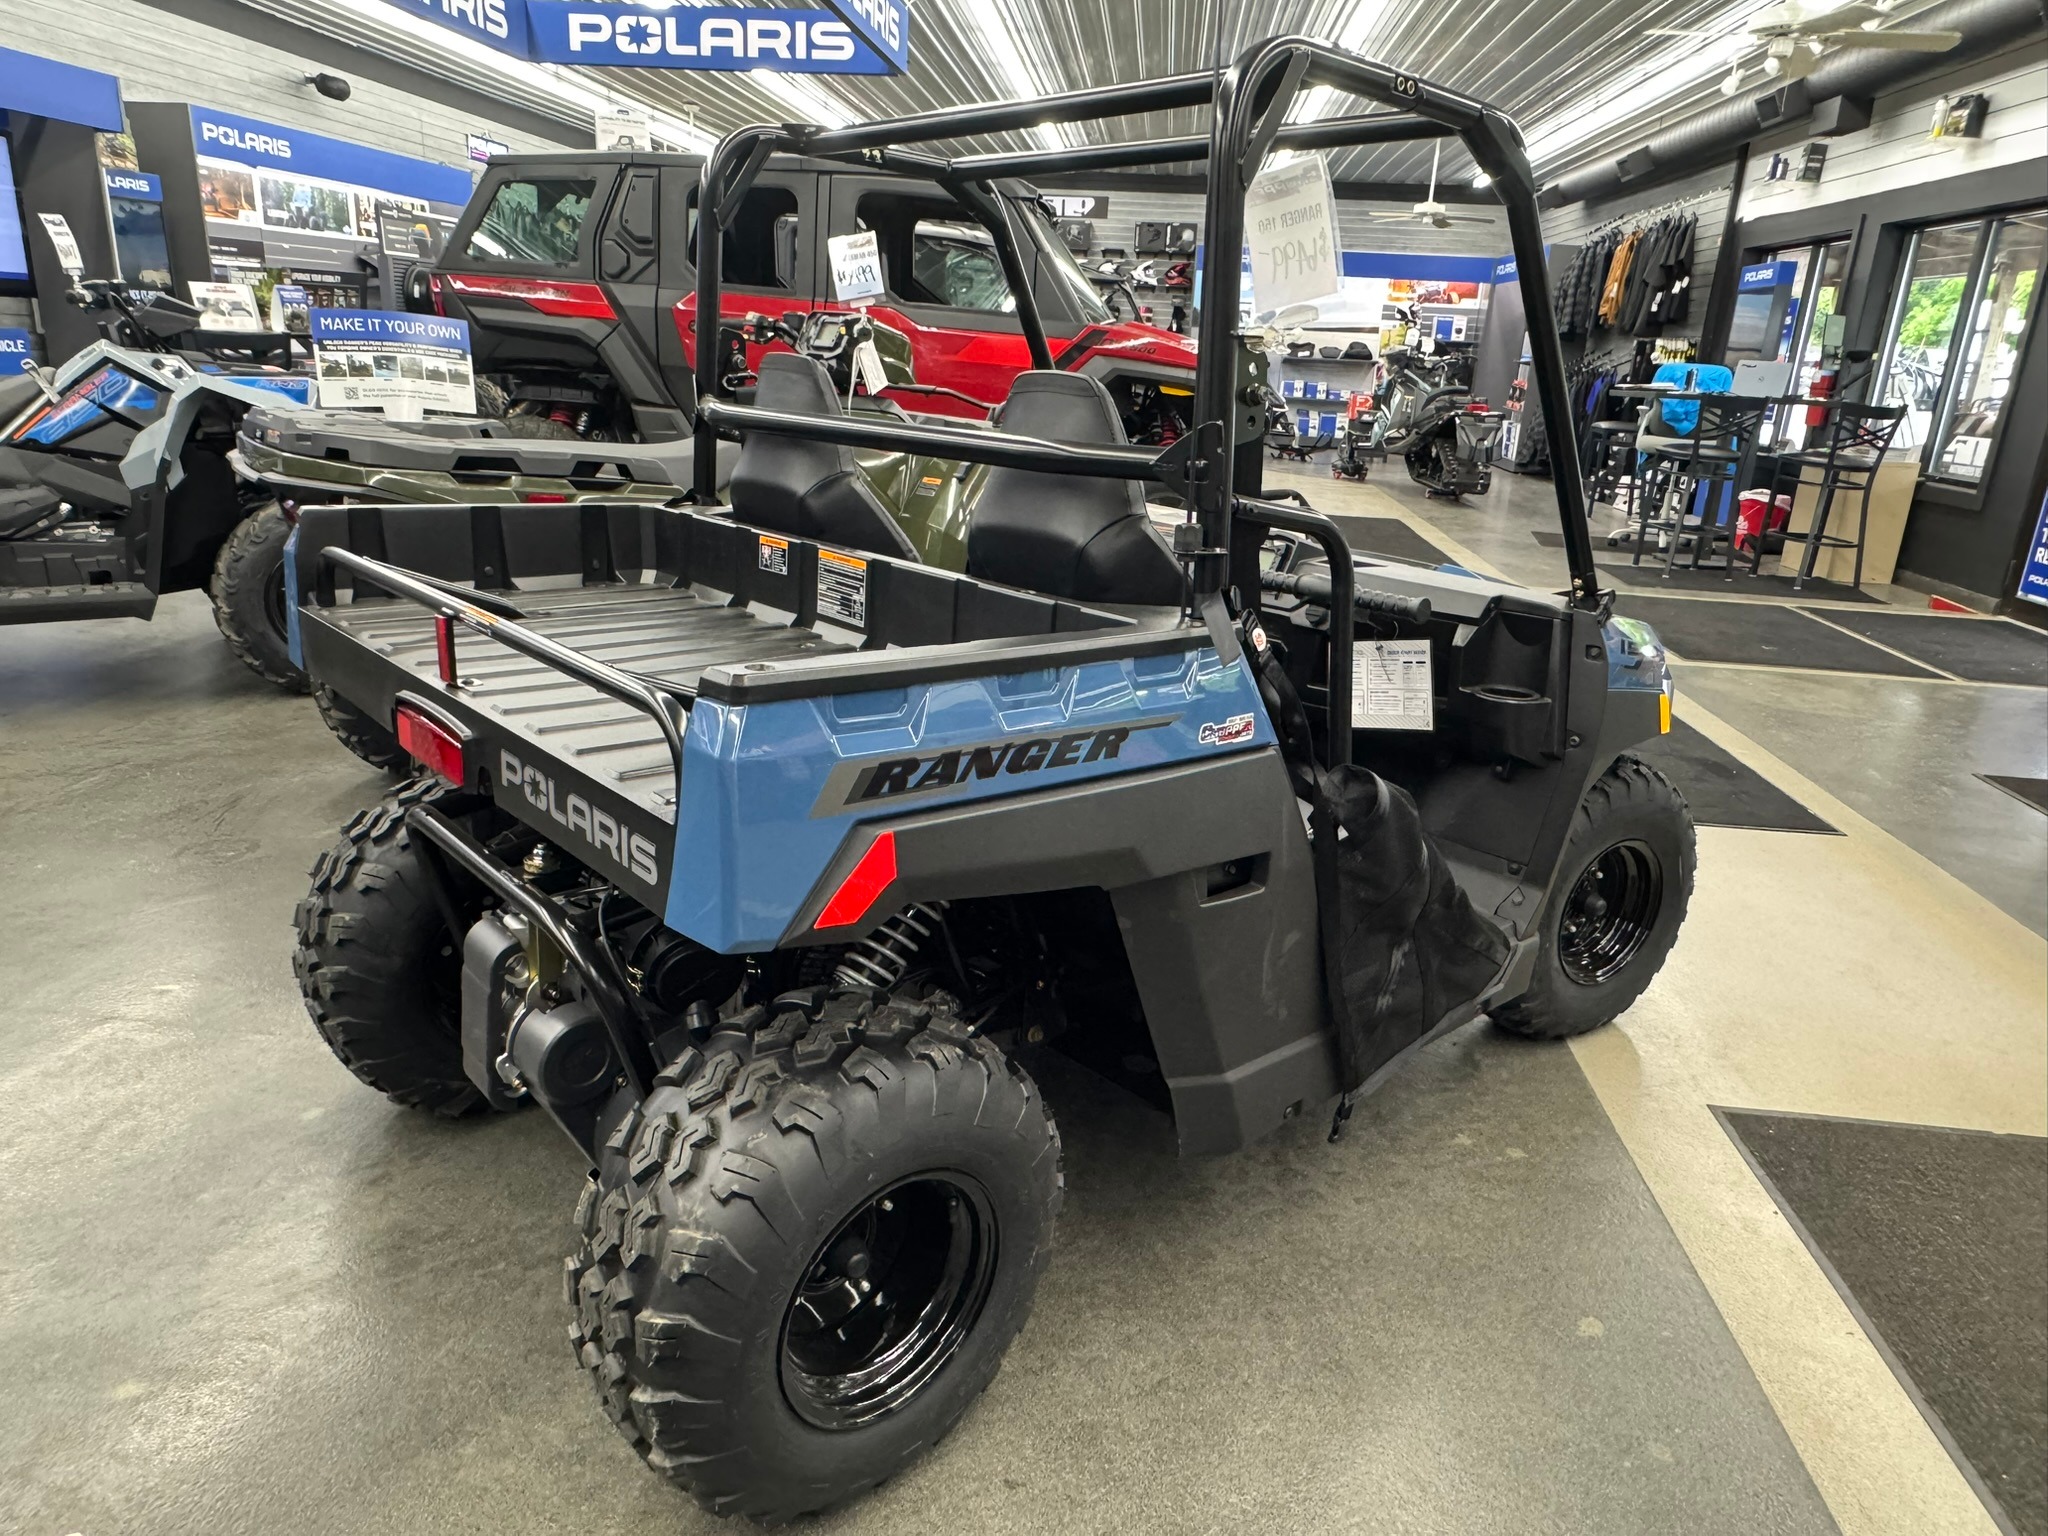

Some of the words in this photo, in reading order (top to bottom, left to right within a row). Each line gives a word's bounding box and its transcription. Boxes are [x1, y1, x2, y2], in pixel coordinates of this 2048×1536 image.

[568, 13, 855, 60] POLARIS
[201, 122, 291, 158] POLARIS
[320, 317, 366, 332] MAKE
[367, 318, 382, 332] IT
[384, 319, 426, 336] YOUR
[428, 324, 462, 341] OWN
[861, 727, 1131, 799] RANGER
[500, 748, 659, 886] POLARIS
